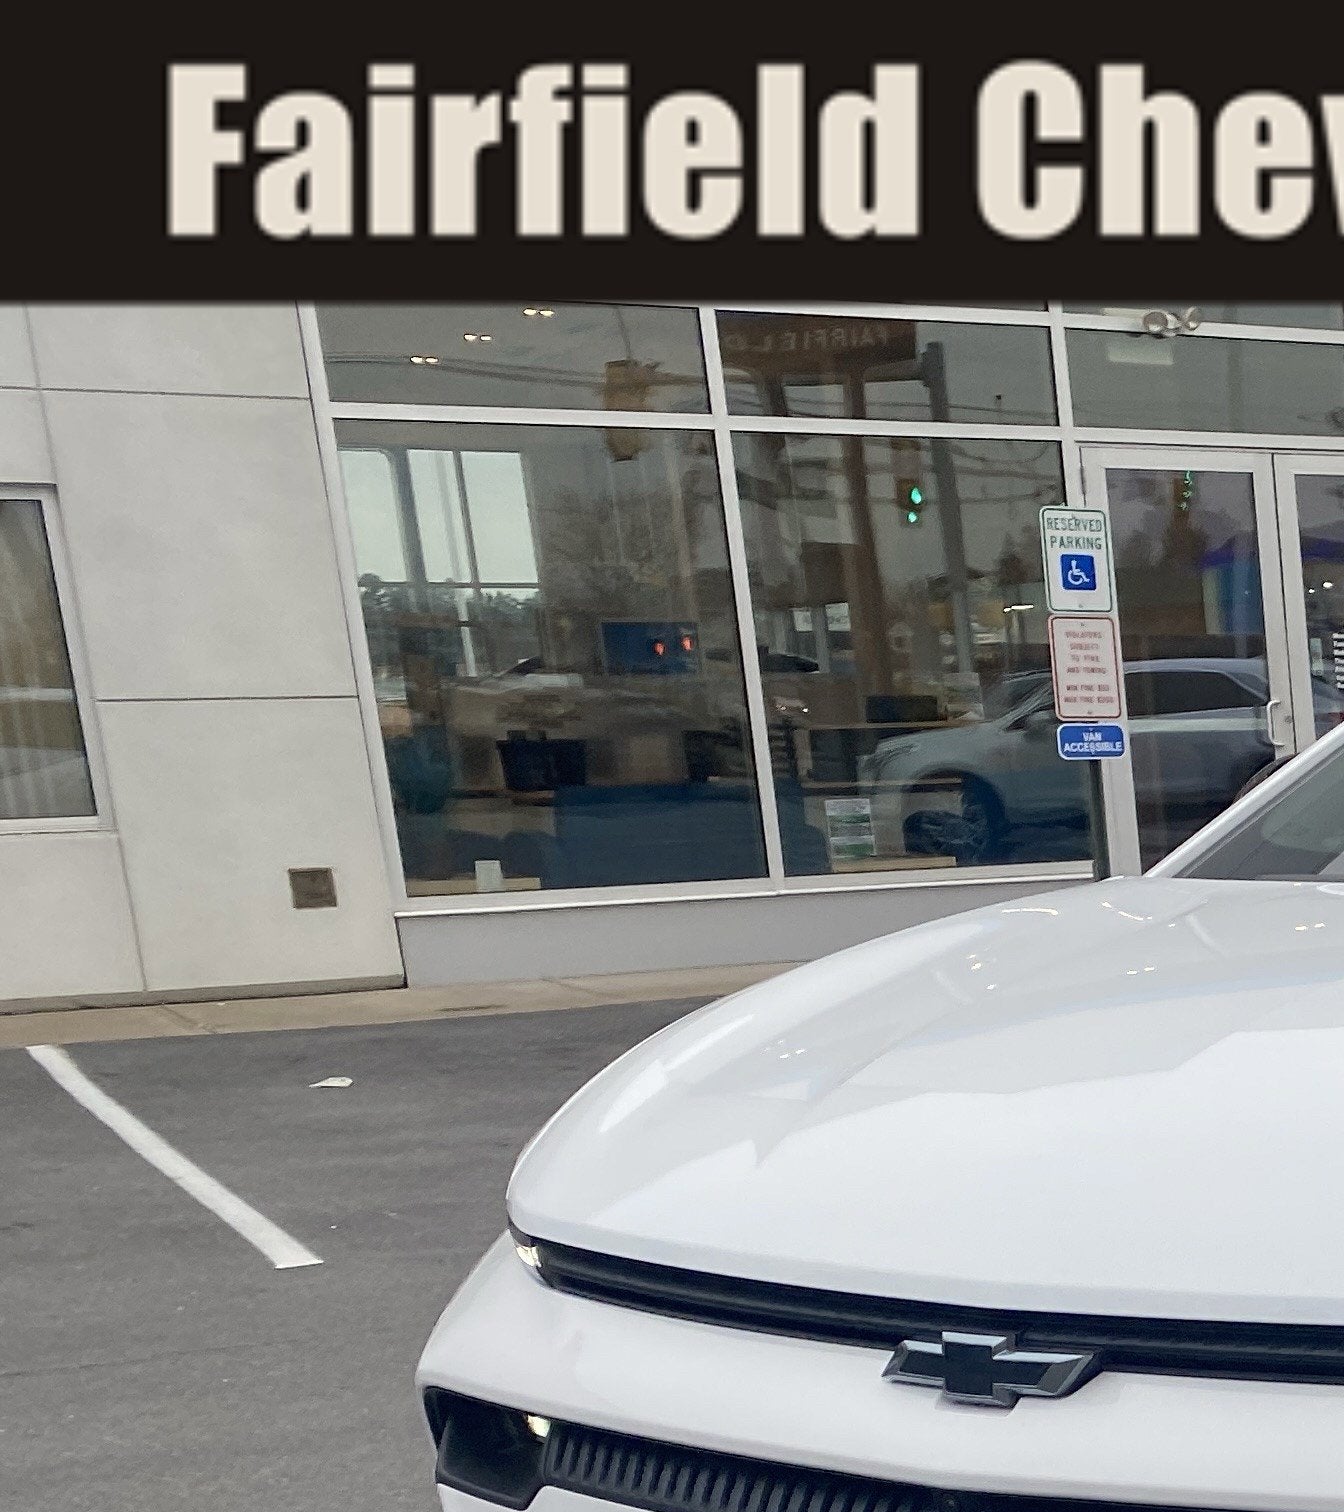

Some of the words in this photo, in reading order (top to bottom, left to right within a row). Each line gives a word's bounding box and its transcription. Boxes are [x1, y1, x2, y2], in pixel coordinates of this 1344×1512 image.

[1046, 517, 1102, 532] RESERVED
[1050, 536, 1102, 550] PARKING
[1082, 731, 1102, 742] VAN
[1064, 741, 1123, 753] ACCESSIBLE
